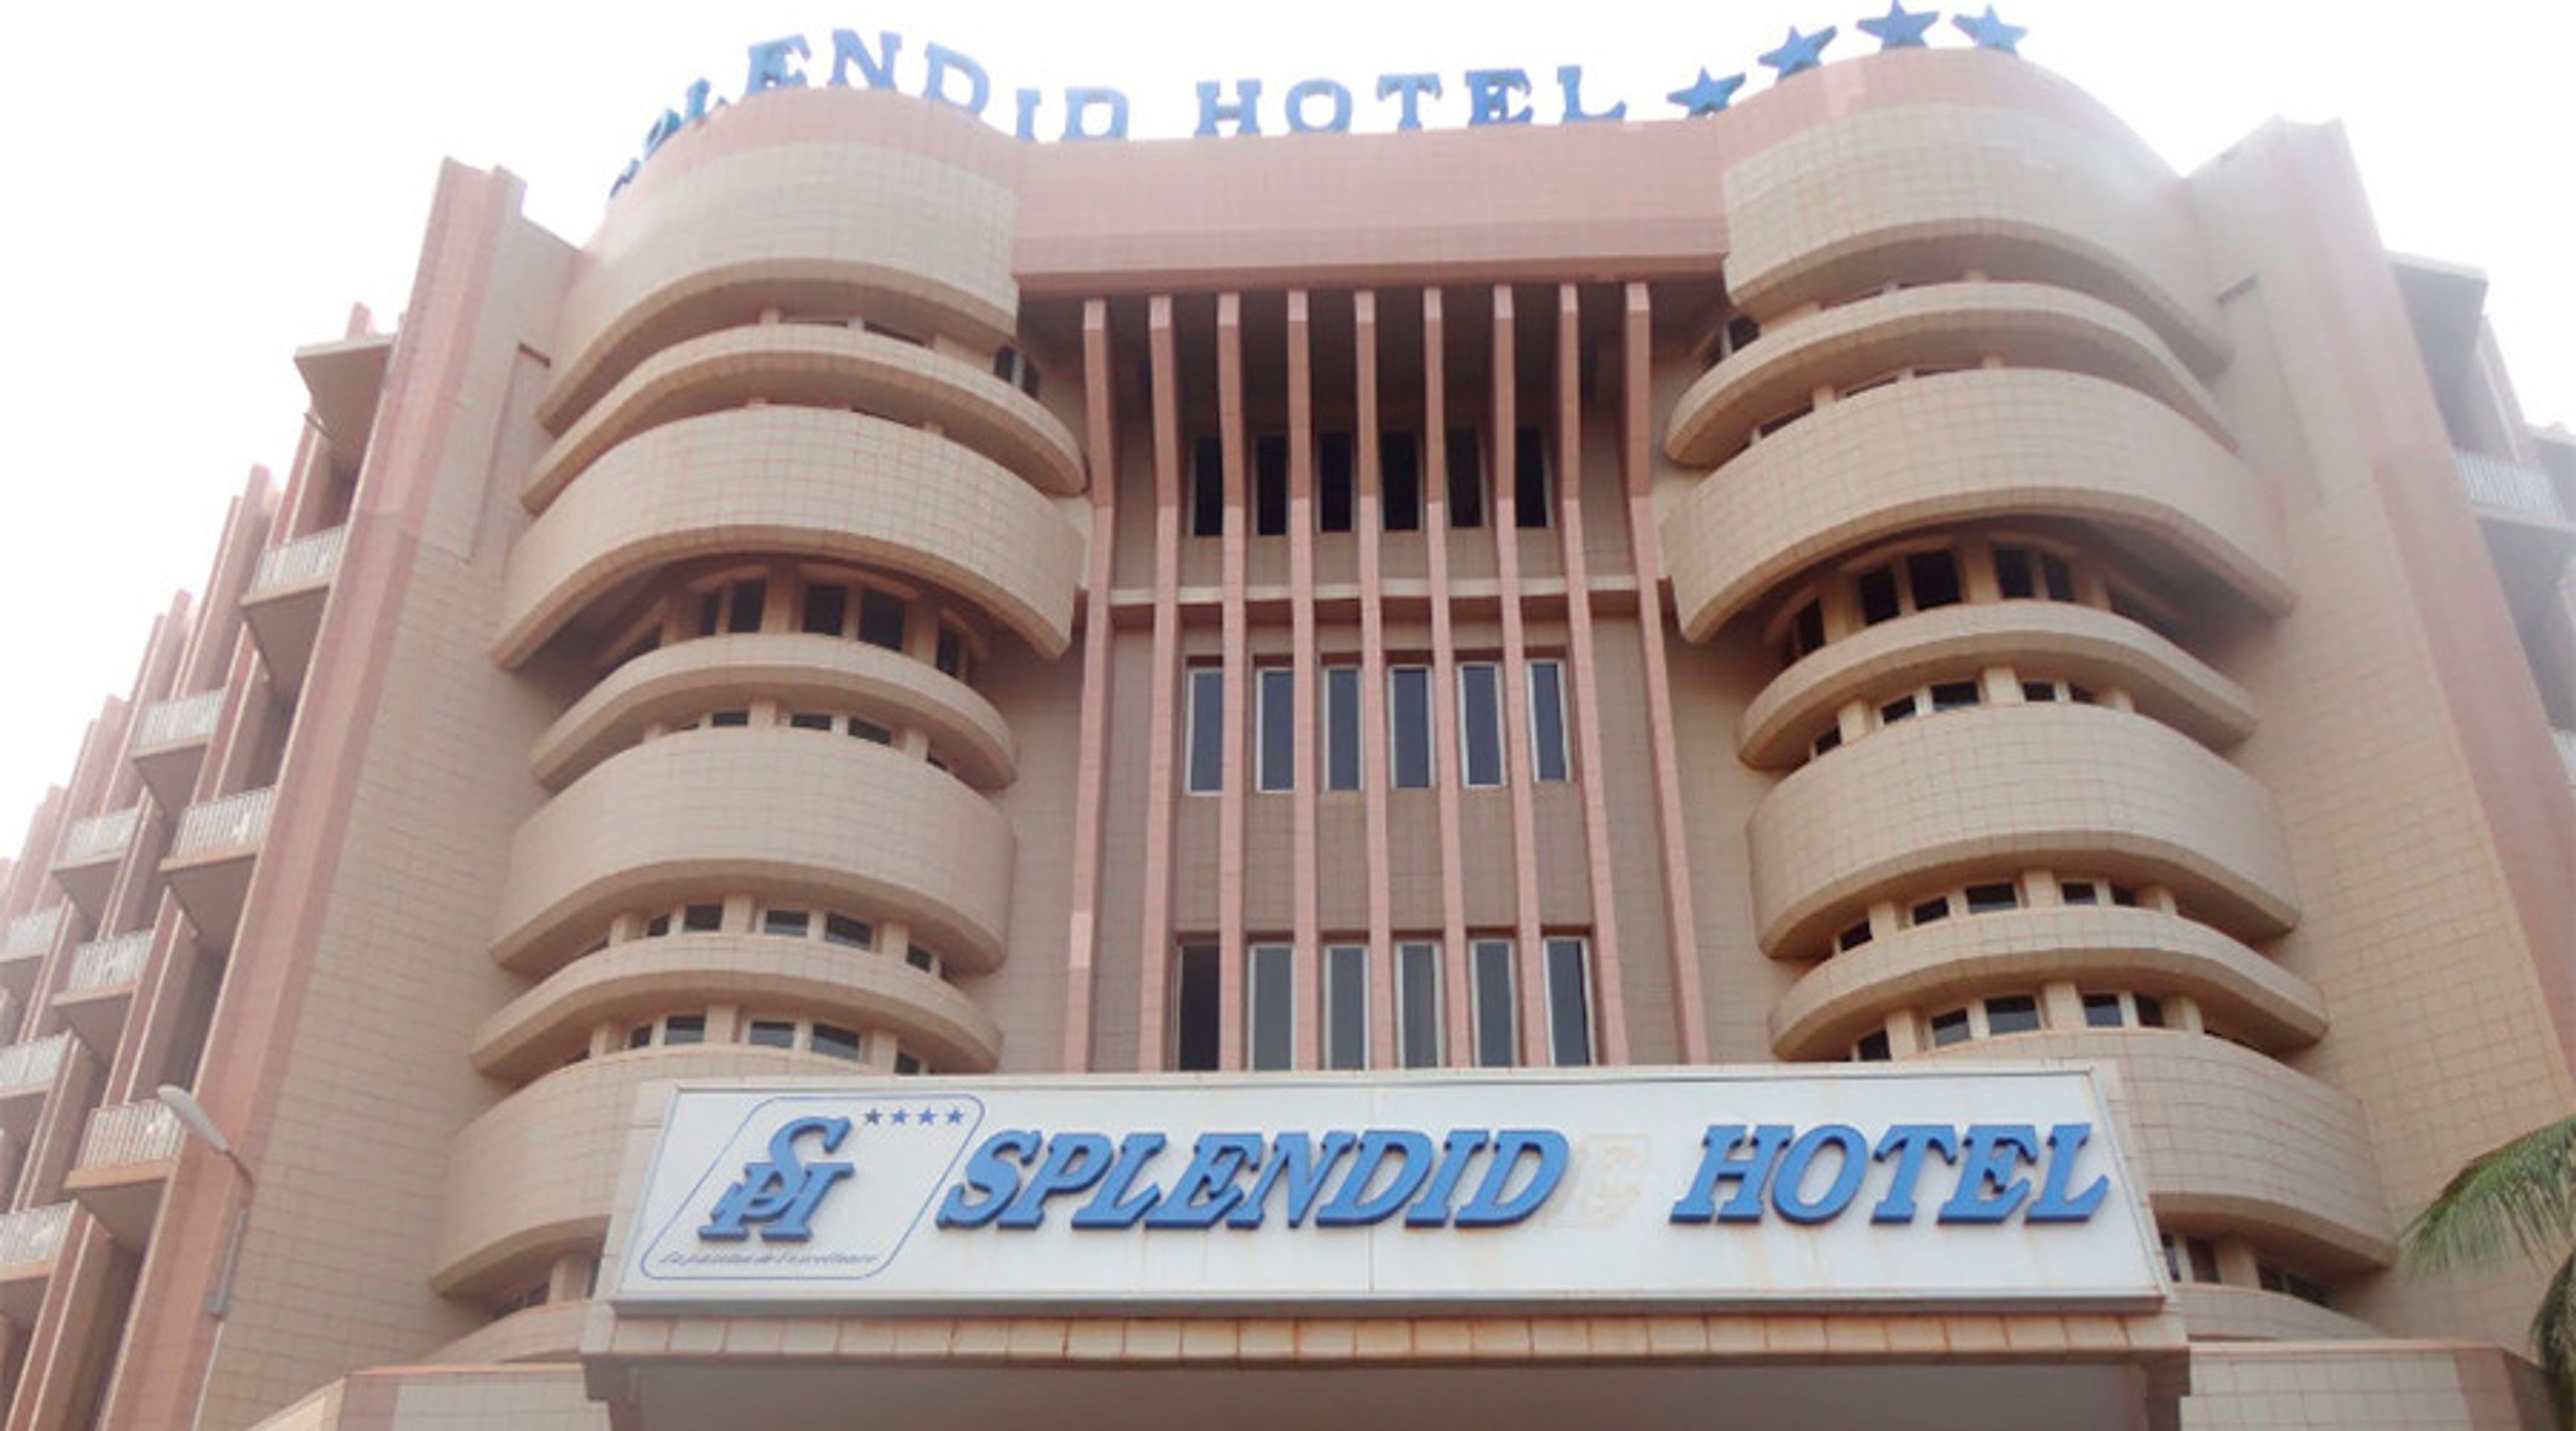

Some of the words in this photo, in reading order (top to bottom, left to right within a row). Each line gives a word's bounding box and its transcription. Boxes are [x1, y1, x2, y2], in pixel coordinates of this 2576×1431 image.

[1194, 65, 1626, 137] HOTEL
[936, 1129, 1570, 1228] SPLENDID
[1670, 1122, 2111, 1225] HOTEL
